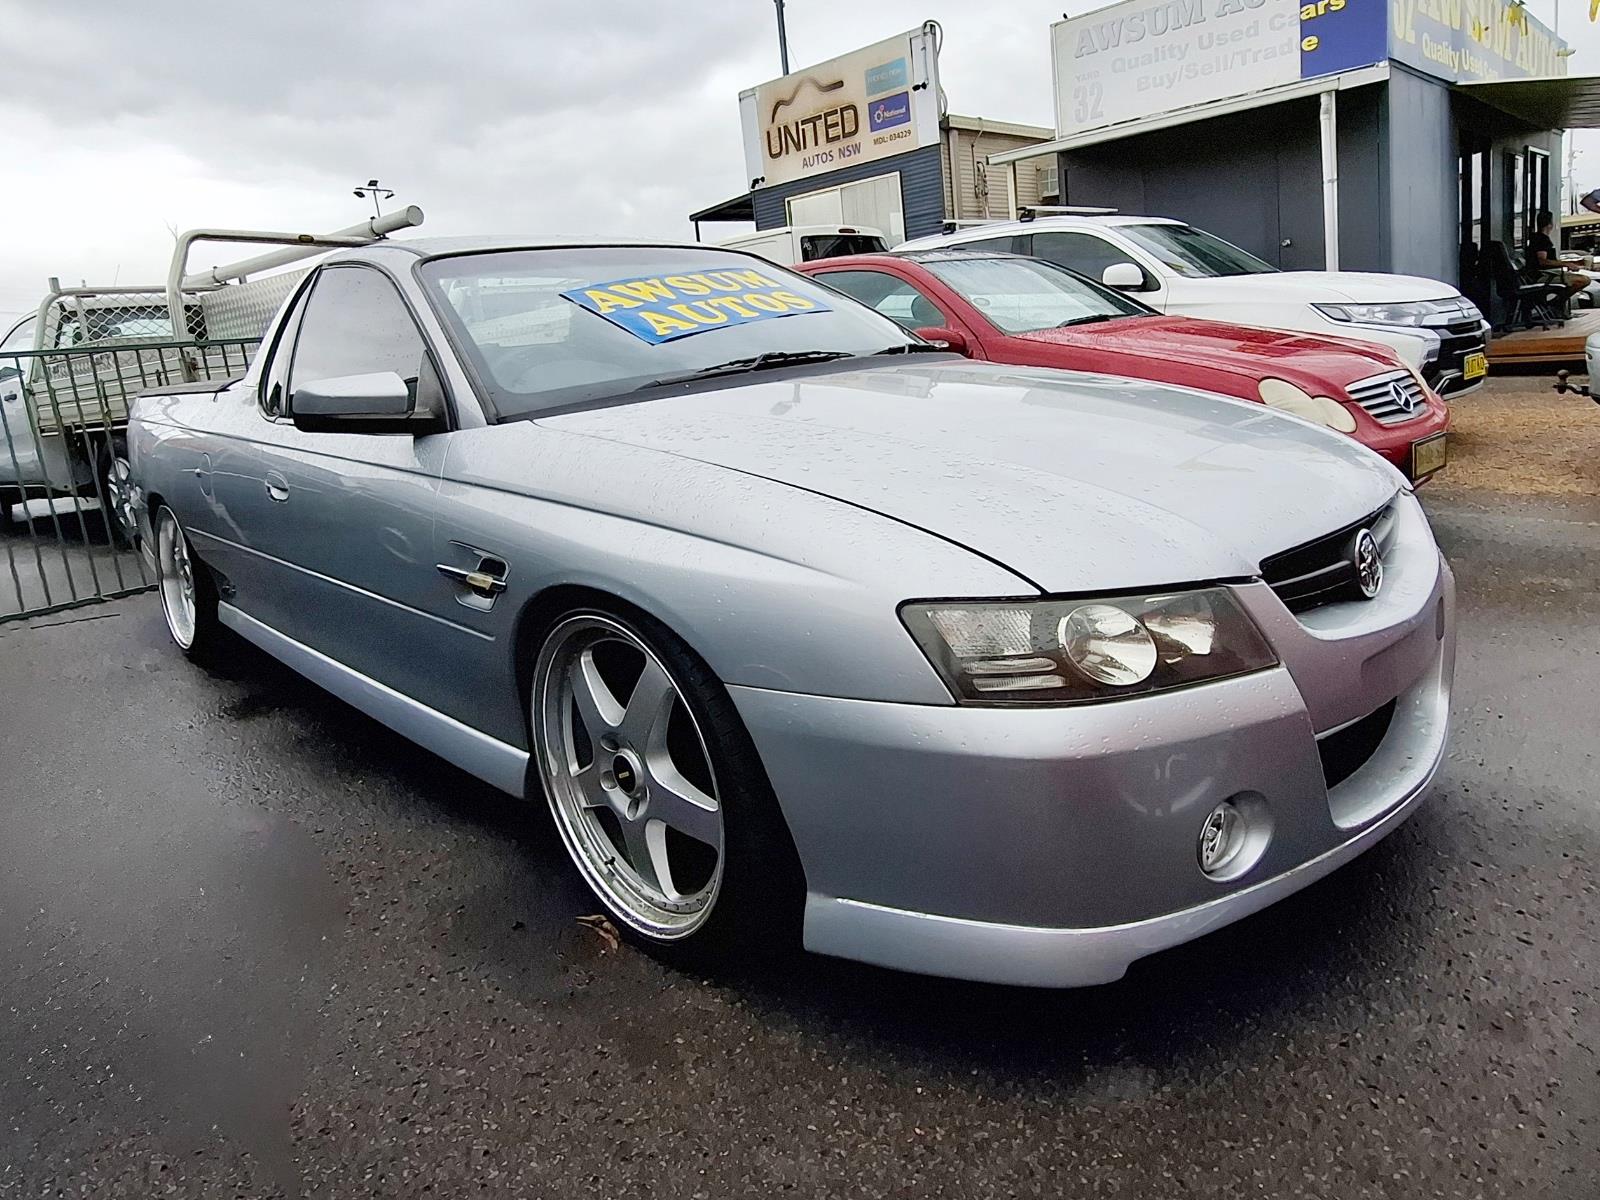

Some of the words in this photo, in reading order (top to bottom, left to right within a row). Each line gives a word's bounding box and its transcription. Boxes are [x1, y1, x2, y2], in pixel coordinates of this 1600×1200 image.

[1074, 0, 1206, 58] AWSUM
[1111, 41, 1190, 74] Quality
[1199, 20, 1260, 50] Used
[1417, 0, 1512, 61] SUM
[1422, 33, 1460, 73] Quality
[1074, 81, 1104, 123] 32
[767, 104, 859, 159] UNITED
[802, 150, 834, 169] AUTOS
[838, 141, 862, 160] NSW
[584, 269, 782, 314] AWSUM
[638, 291, 816, 336] AUTOS
